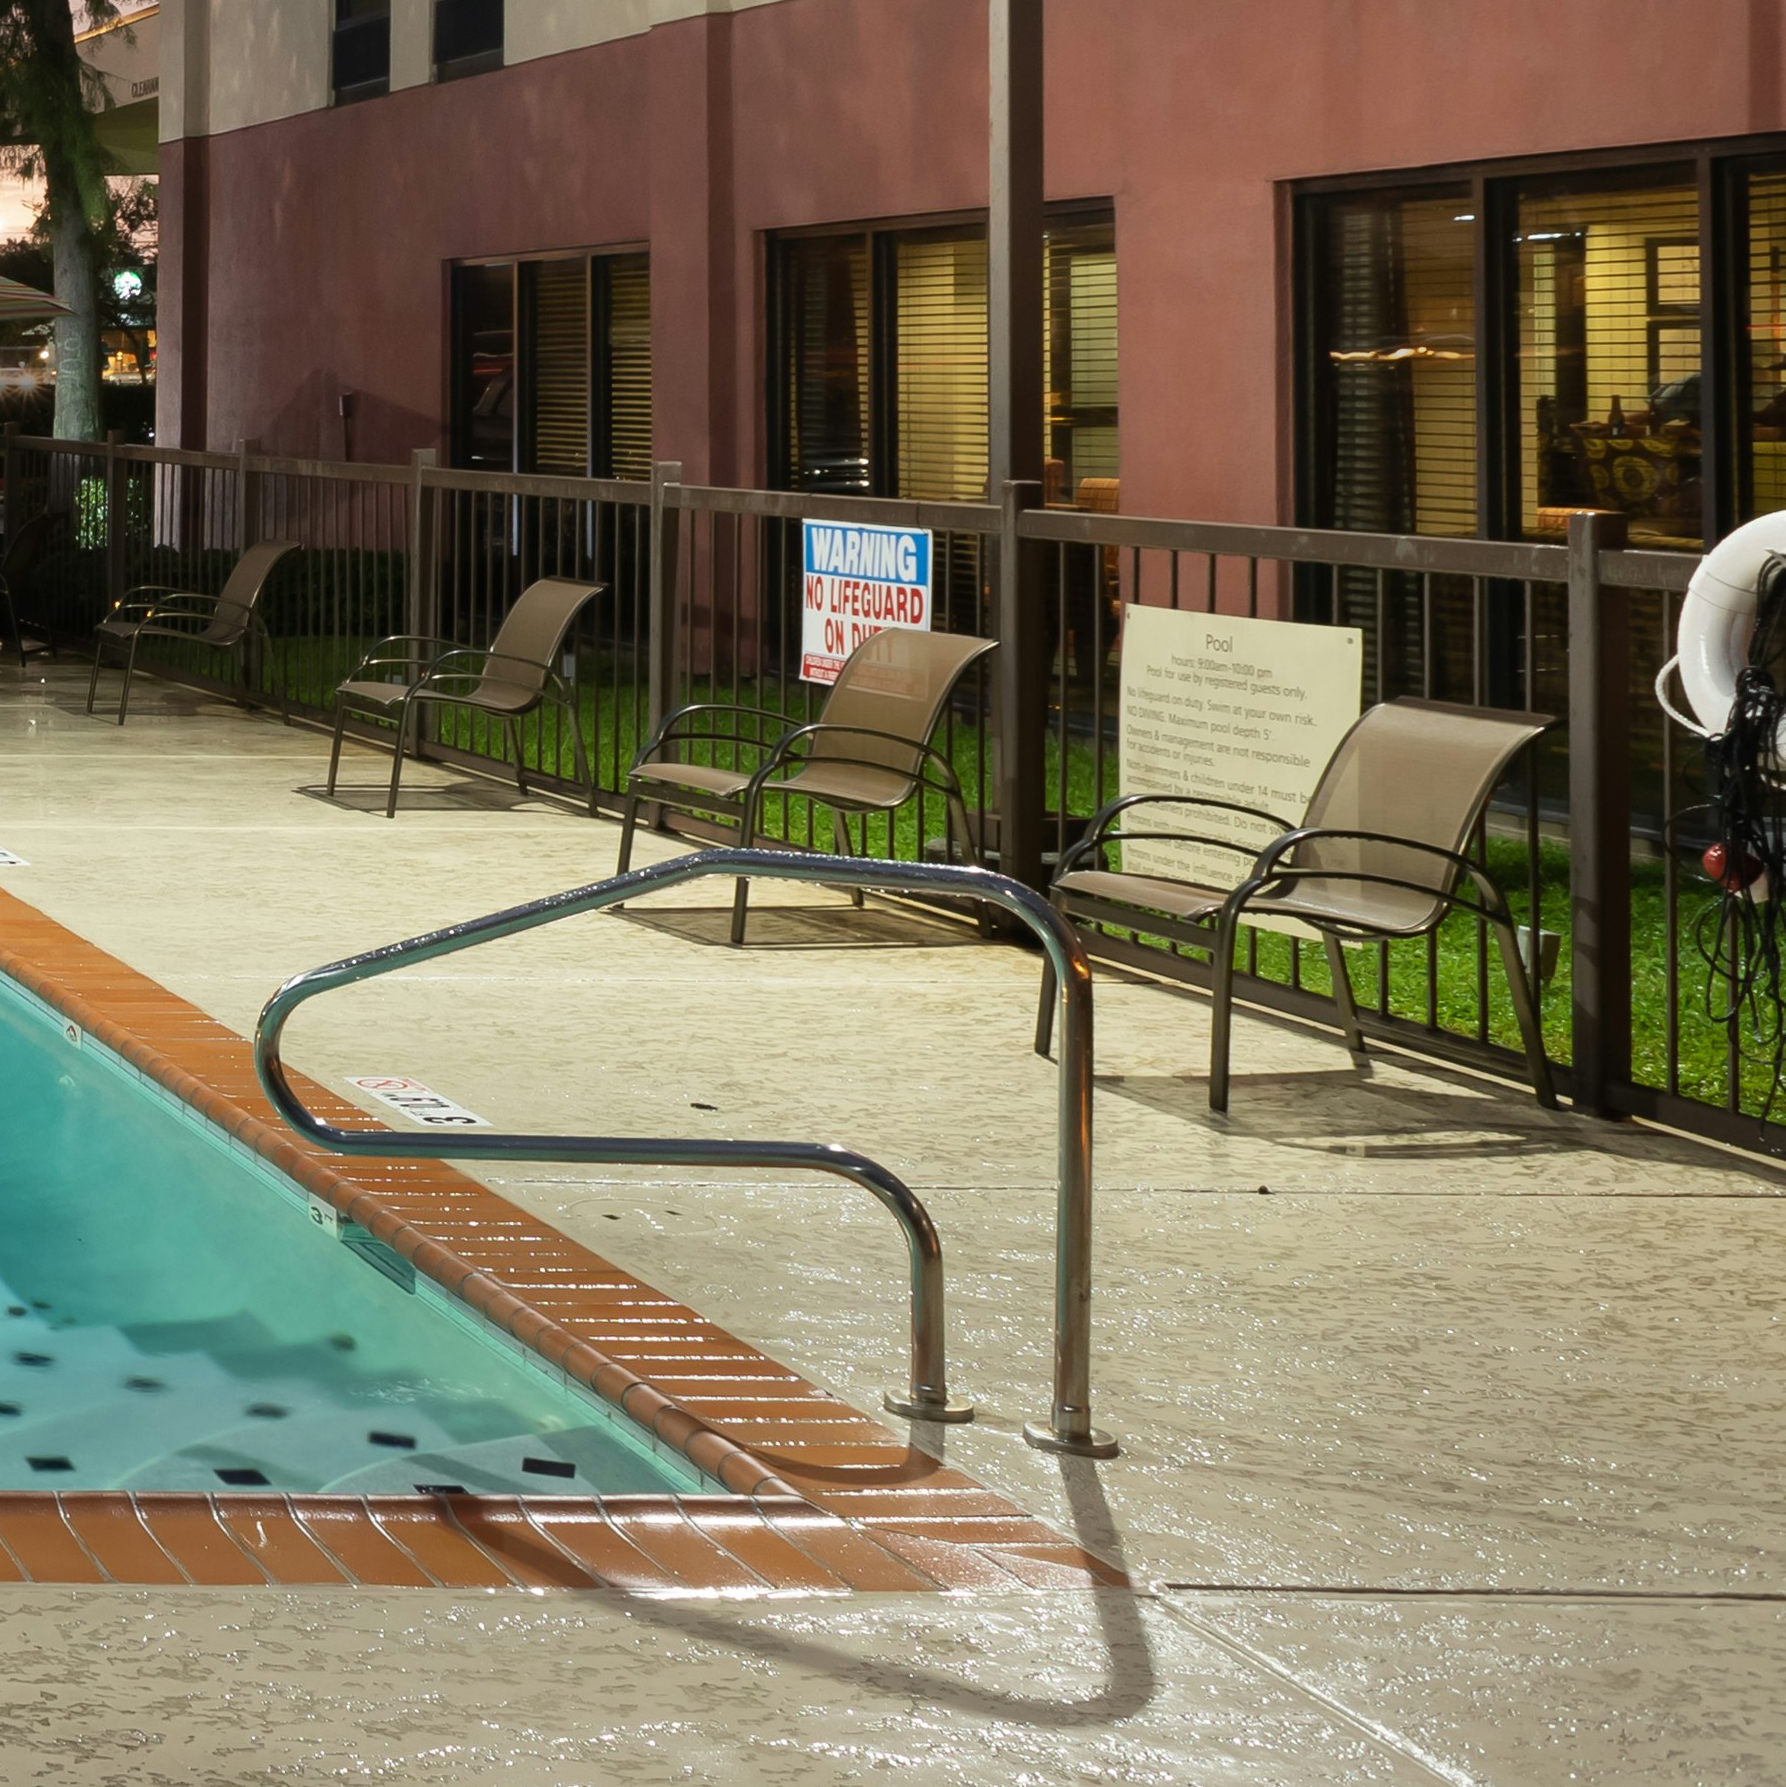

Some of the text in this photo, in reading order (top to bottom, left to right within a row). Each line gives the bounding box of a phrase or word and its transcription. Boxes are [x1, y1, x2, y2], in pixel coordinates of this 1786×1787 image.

[811, 527, 917, 582] WARNING
[806, 575, 924, 625] NO LIFEGUARD
[824, 618, 845, 655] ON
[1206, 633, 1232, 652] Pool
[1147, 664, 1307, 702] Pool for use by registered guests only.
[1257, 667, 1272, 680] pm
[1126, 704, 1137, 716] NO
[1169, 712, 1208, 730] Maximum
[1211, 719, 1230, 736] pool
[1234, 723, 1260, 741] depth
[1127, 685, 1316, 727] No lifeguard on duty. Swim at your own risk.
[1127, 724, 1310, 772] Owners & management are not responsible
[1172, 750, 1180, 759] or
[1183, 751, 1214, 769] injuries.
[1174, 783, 1182, 797] by
[1183, 770, 1188, 781] &
[1190, 771, 1224, 789] children
[1227, 779, 1254, 795] under
[1257, 785, 1267, 797] 14
[1271, 786, 1296, 803] must
[1234, 816, 1247, 830] Do
[1251, 819, 1266, 833] not
[1152, 852, 1174, 868] under
[1177, 860, 1190, 871] the
[1192, 862, 1232, 883] influence
[1203, 845, 1240, 866] entering
